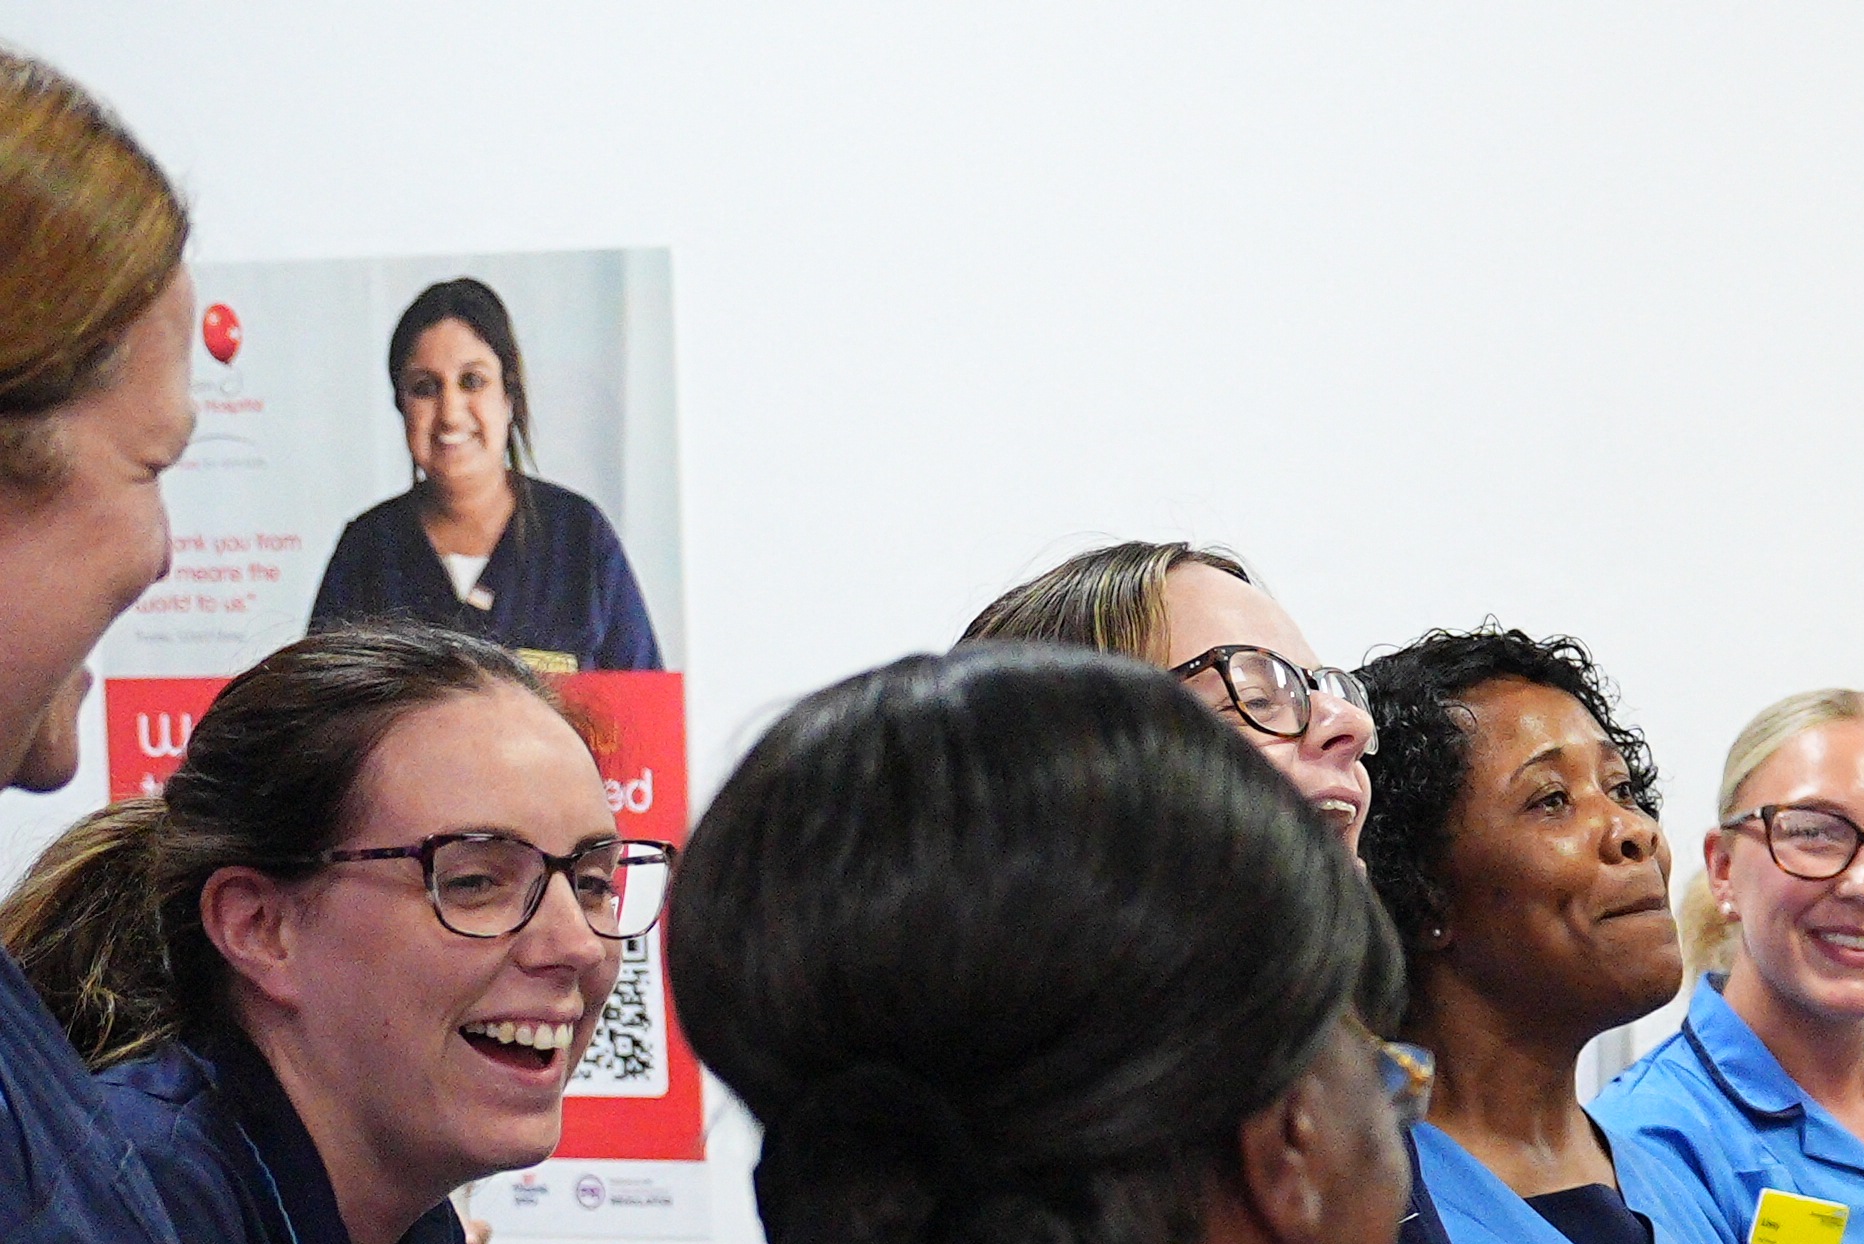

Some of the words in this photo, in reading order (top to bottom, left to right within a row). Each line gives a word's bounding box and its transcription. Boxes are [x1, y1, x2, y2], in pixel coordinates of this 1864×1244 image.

[213, 535, 250, 557] you
[256, 532, 302, 552] from
[176, 564, 244, 583] means
[249, 560, 282, 582] the
[198, 594, 218, 614] to
[603, 765, 655, 814] ed
